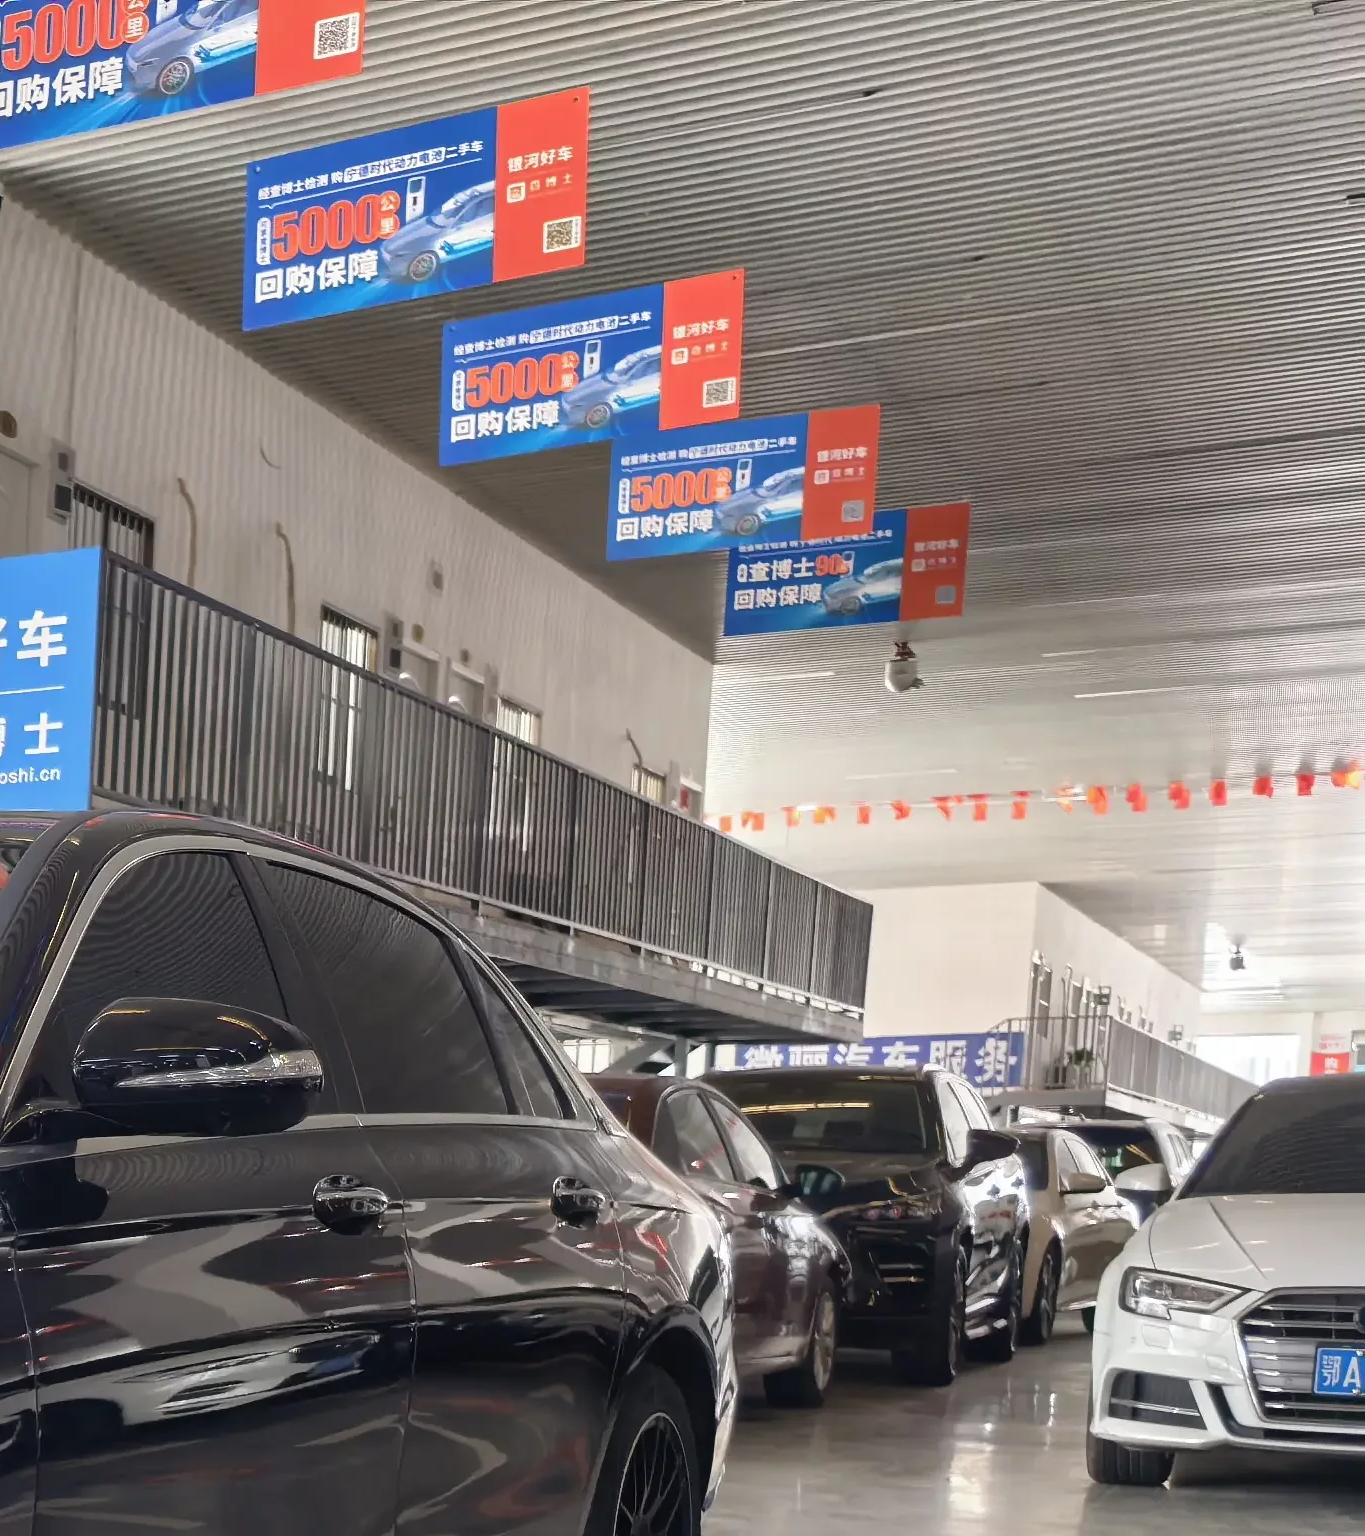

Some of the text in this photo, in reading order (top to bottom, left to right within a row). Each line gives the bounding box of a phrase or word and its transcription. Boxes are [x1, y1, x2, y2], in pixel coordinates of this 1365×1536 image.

[2, 0, 125, 70] 5000
[507, 146, 573, 173] 银河好车
[272, 194, 382, 261] 5000
[255, 249, 378, 303] 回购保障
[465, 353, 563, 408] 5000
[450, 400, 559, 443] 回购保障
[631, 468, 717, 512] 5000
[616, 508, 714, 541] 回购保障
[734, 583, 822, 611] 回购保障
[1321, 1355, 1361, 1388] 鄂A
